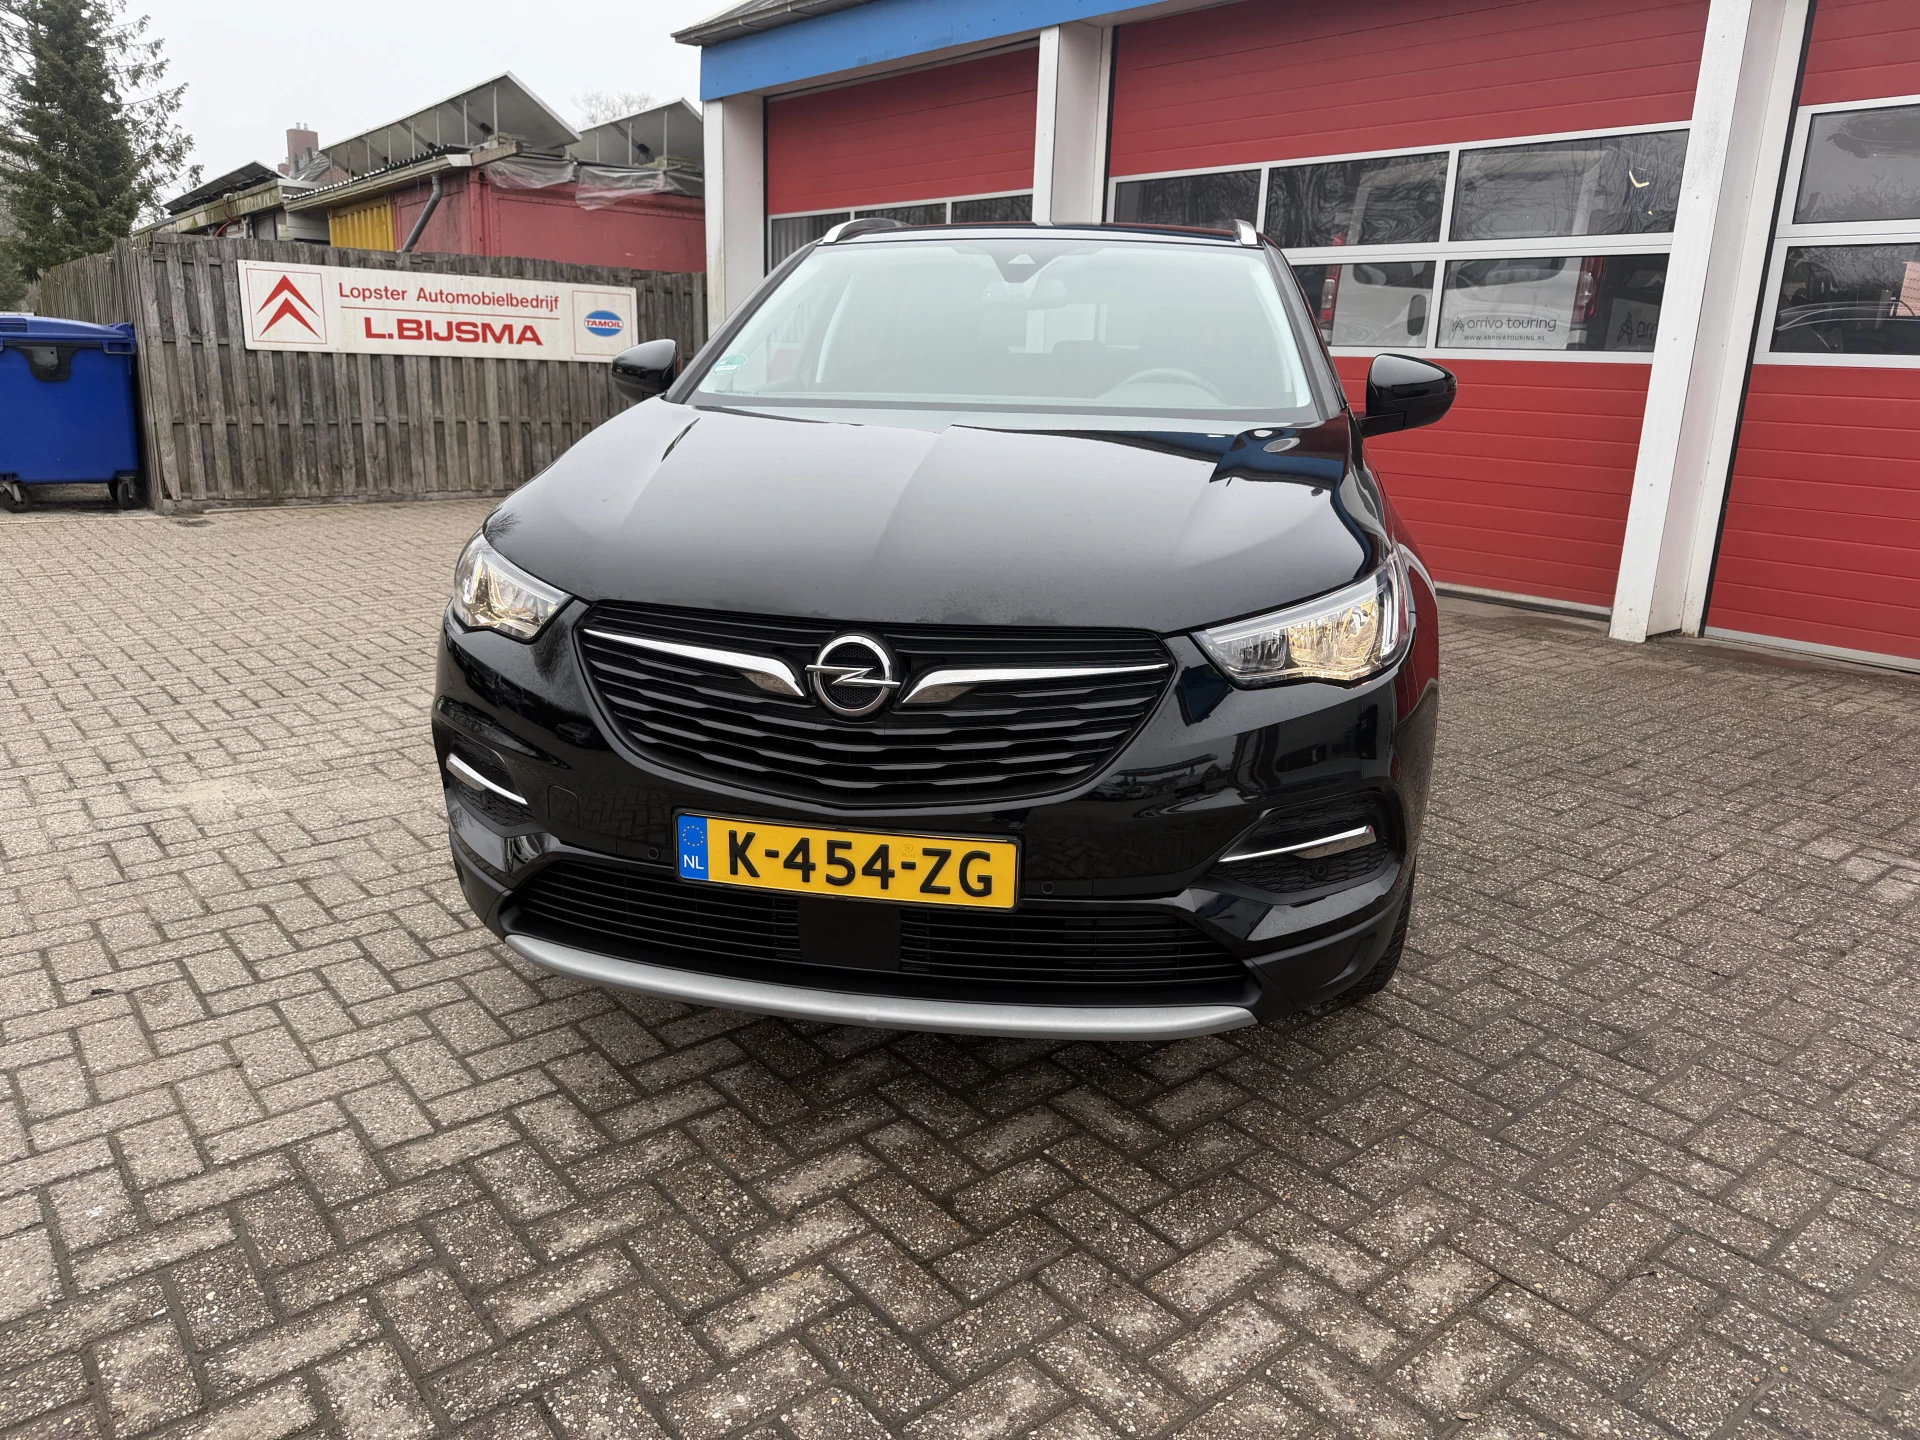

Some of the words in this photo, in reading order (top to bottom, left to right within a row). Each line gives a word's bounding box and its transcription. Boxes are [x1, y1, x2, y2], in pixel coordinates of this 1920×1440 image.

[338, 282, 408, 302] Lopster
[416, 287, 560, 312] Automobielbedrijf
[364, 317, 543, 346] L.BIJSMA
[585, 319, 623, 328] TAMOIL
[1466, 317, 1504, 329] arriva
[1506, 316, 1557, 332] touring
[683, 854, 704, 870] NL
[728, 829, 993, 898] K-454-ZG
